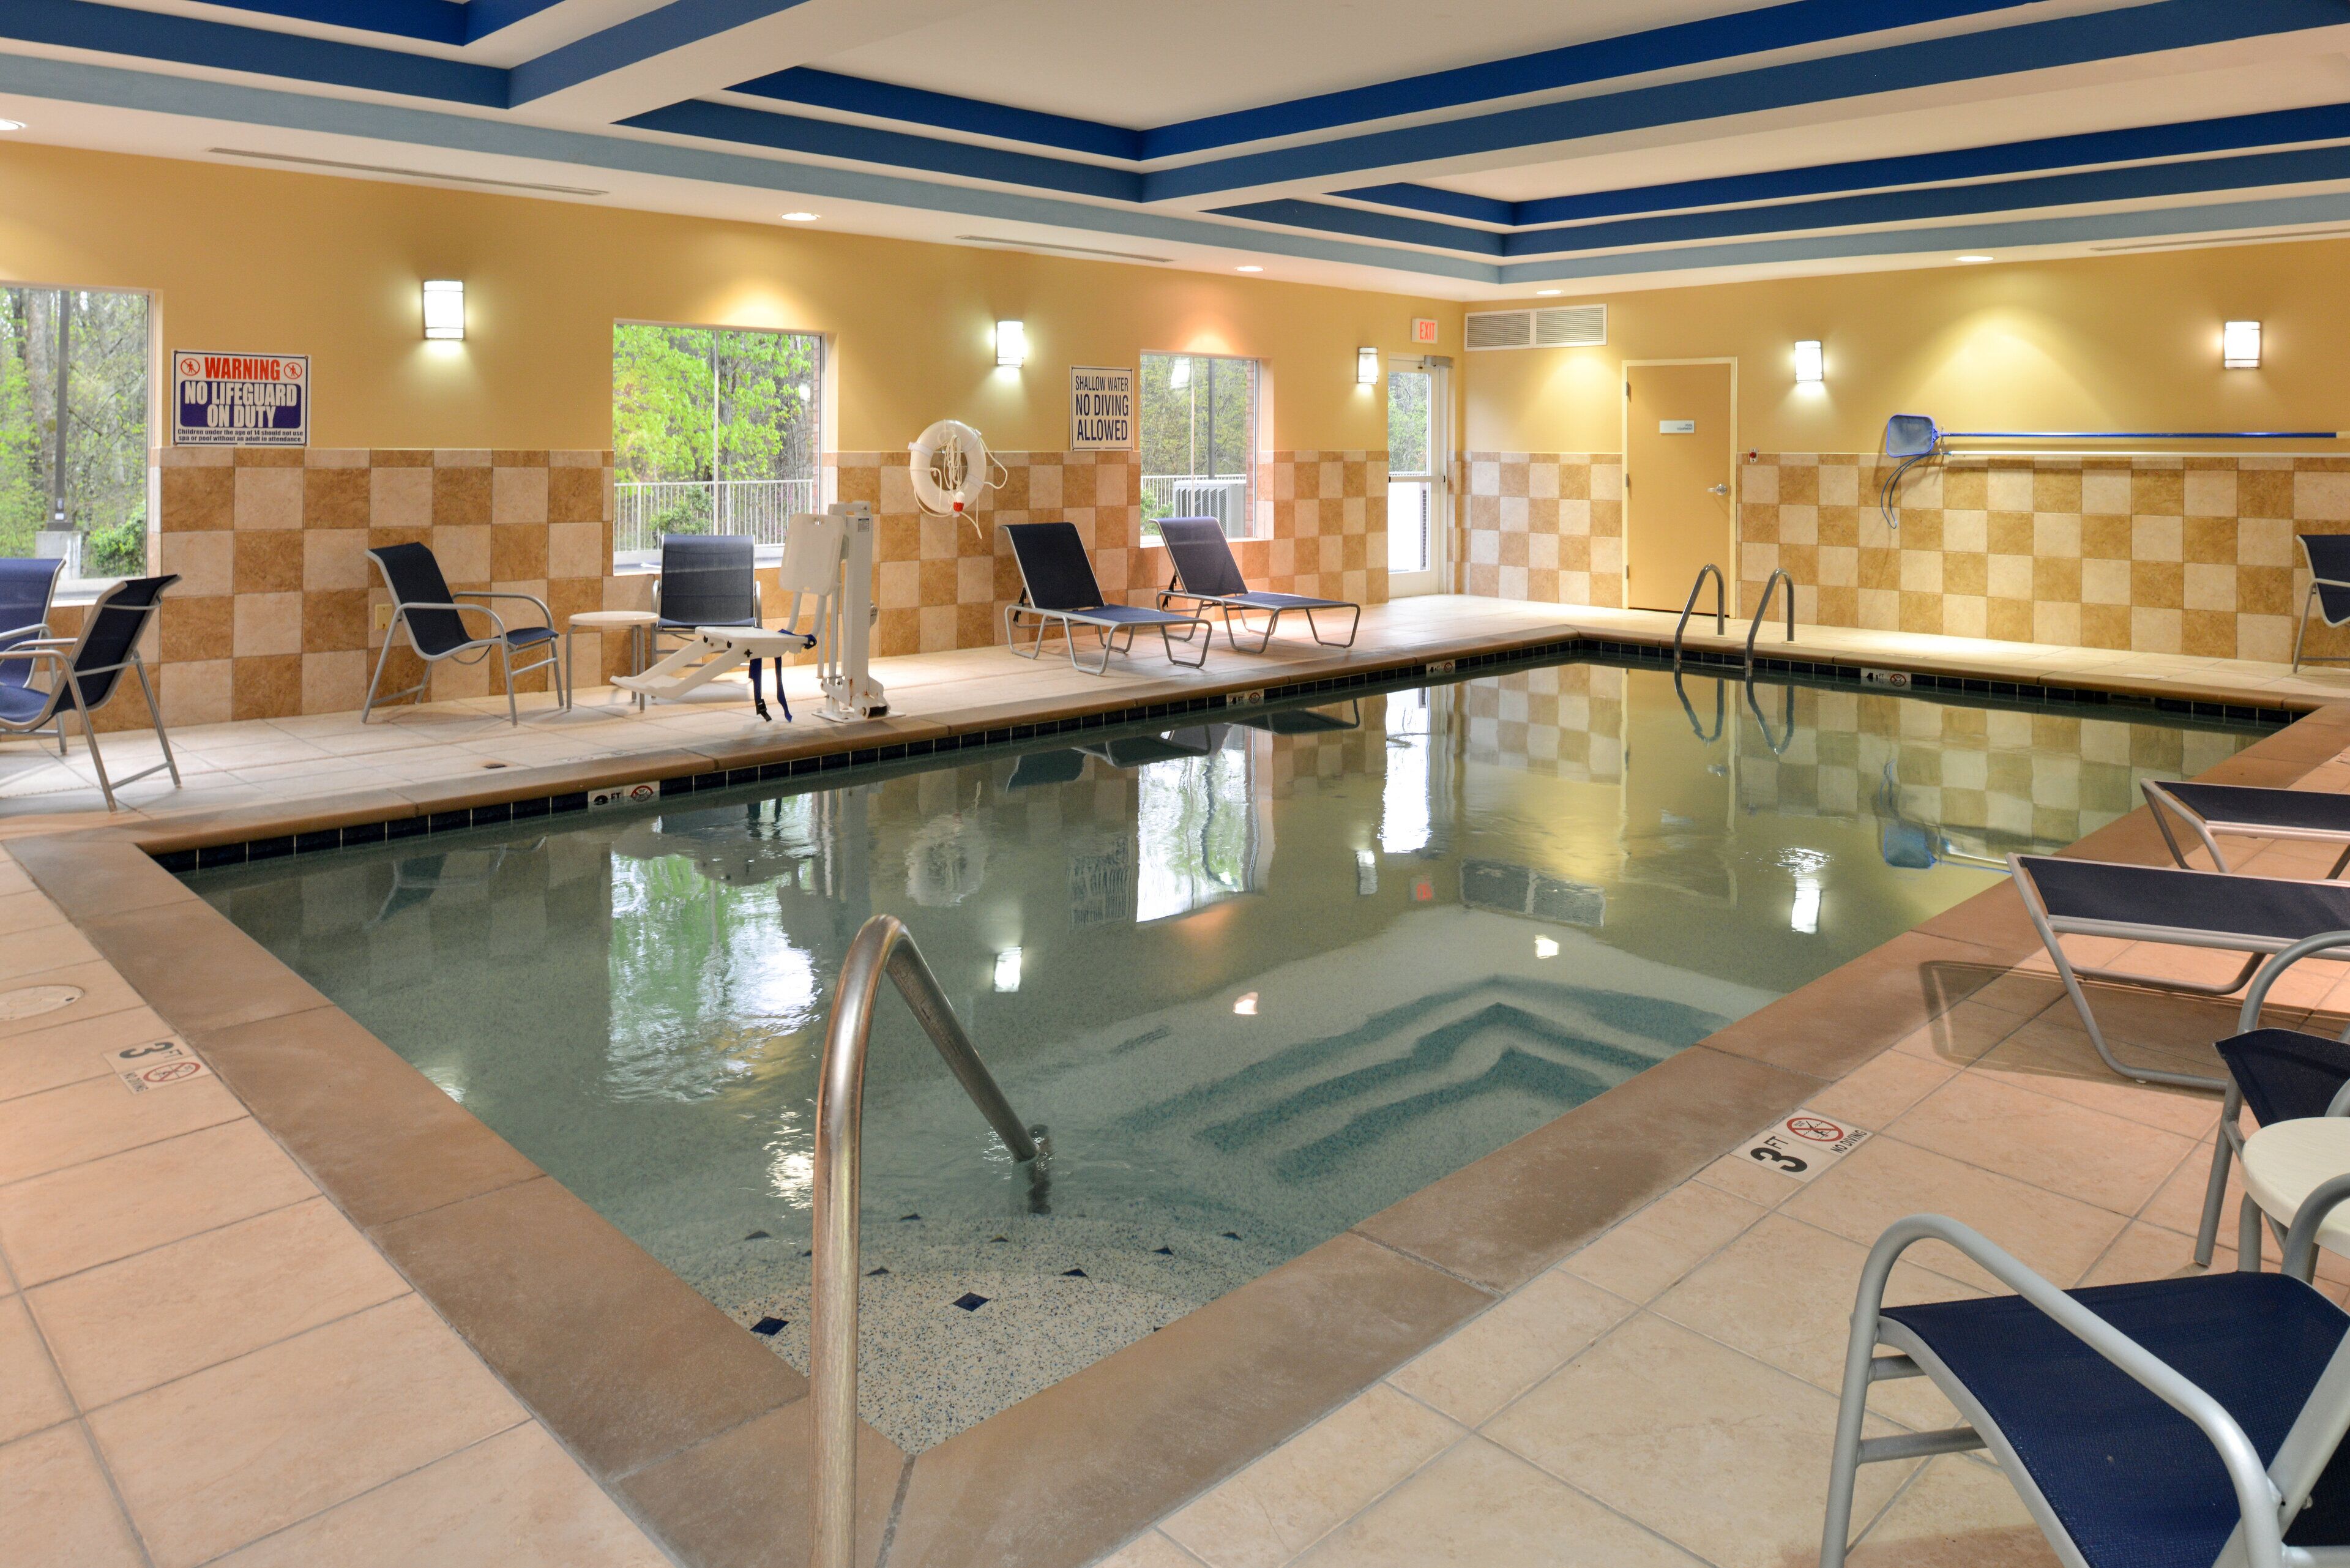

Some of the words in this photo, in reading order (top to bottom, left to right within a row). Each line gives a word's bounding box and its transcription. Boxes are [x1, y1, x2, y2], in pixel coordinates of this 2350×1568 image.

[1420, 321, 1435, 340] EXIT
[204, 357, 280, 381] WARNING
[184, 381, 208, 405] NO
[211, 382, 297, 406] LIFEGUARD
[1075, 375, 1106, 391] SHALLOW
[1108, 376, 1128, 392] WATER
[207, 405, 229, 428] ON
[234, 406, 277, 428] DUTY
[1076, 394, 1091, 416] NO
[1094, 394, 1129, 417] DIVING
[1077, 419, 1128, 441] ALLOWED
[119, 1042, 174, 1059] 3
[1763, 1135, 1788, 1149] FT
[1830, 1144, 1848, 1154] NO
[1840, 1129, 1867, 1147] DIVING
[1750, 1147, 1808, 1173] 3
